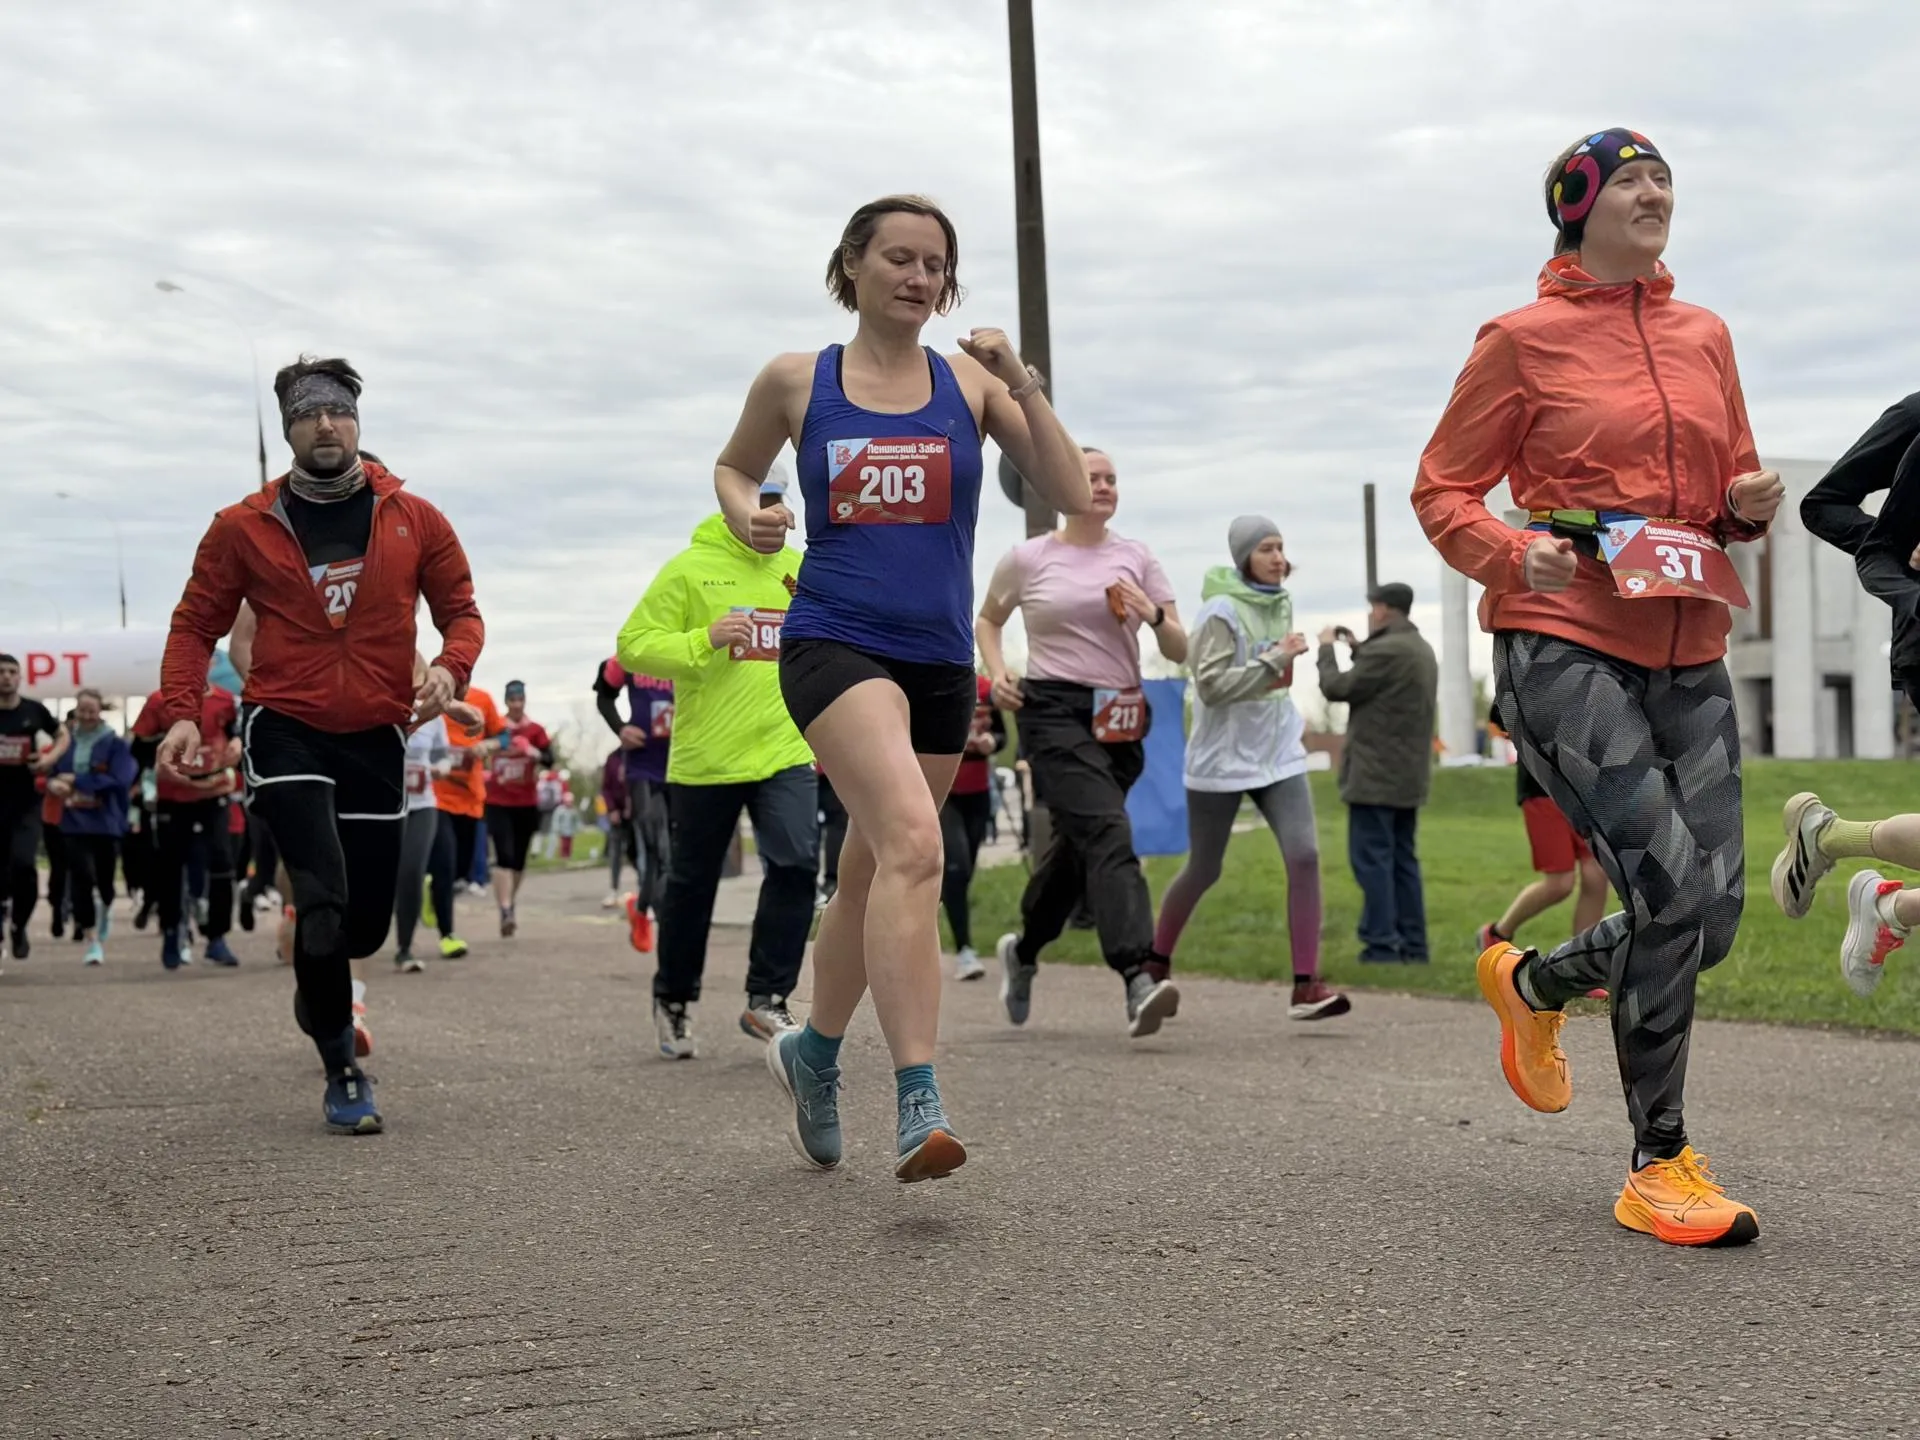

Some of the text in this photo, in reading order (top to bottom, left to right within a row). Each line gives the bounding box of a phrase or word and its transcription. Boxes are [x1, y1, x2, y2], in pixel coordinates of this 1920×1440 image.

[867, 443, 917, 454] Ленинский
[860, 465, 925, 503] 203
[1656, 545, 1703, 581] 37
